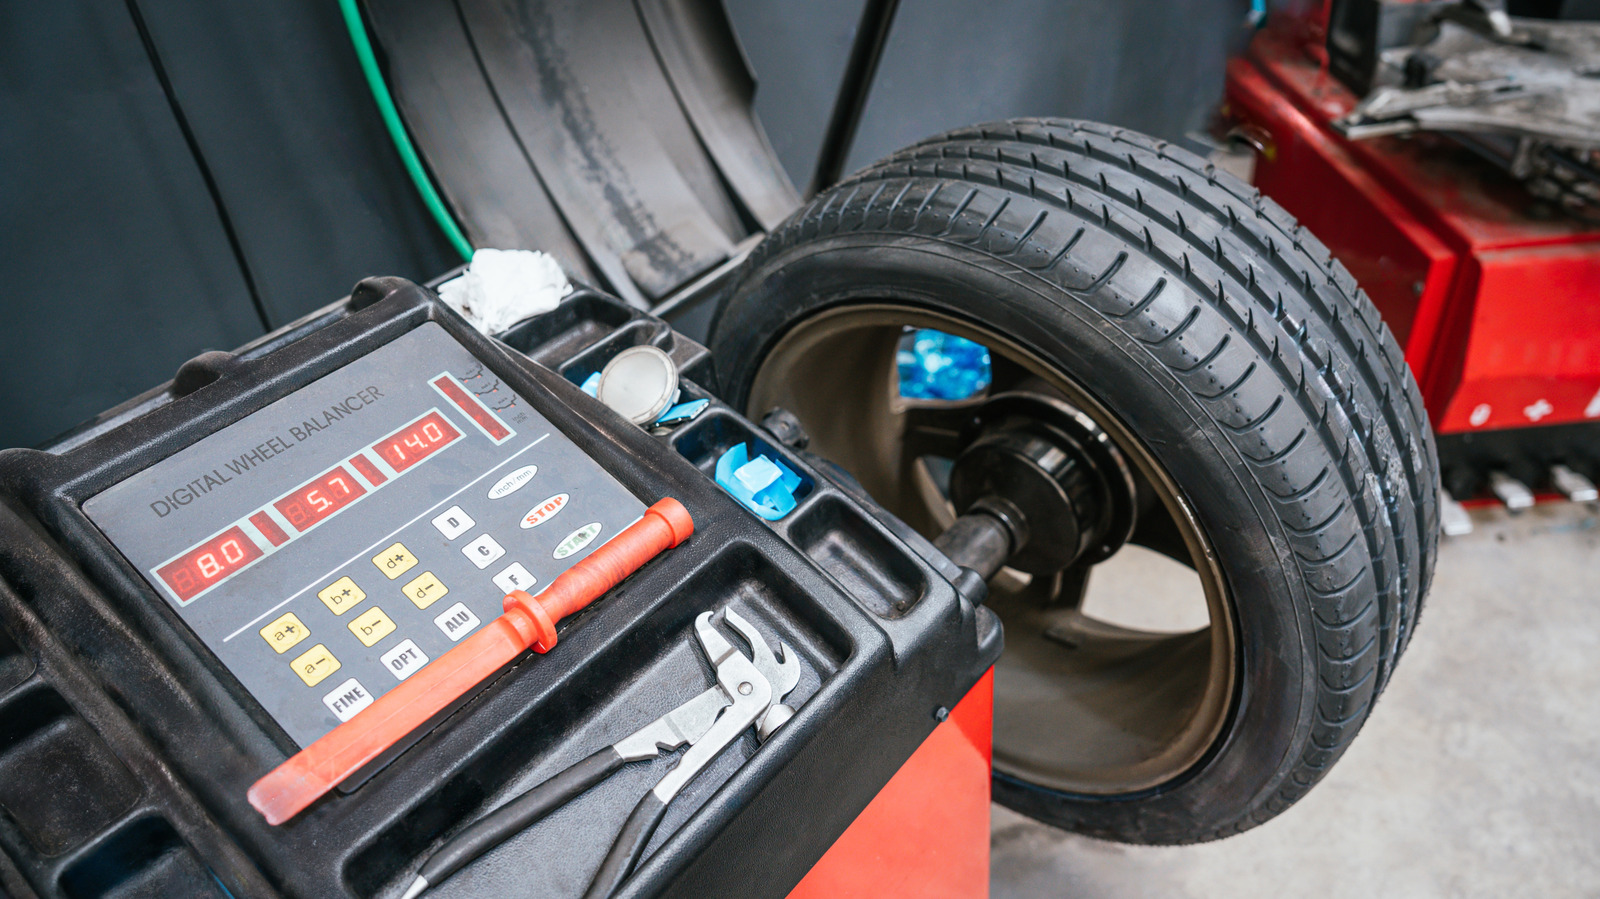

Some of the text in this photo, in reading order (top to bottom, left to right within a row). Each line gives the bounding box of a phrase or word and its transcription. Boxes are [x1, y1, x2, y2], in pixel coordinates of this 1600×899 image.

[150, 385, 385, 518] DIGITAL WHEEL BALANCER
[393, 422, 444, 460] 14.0
[494, 469, 532, 495] inch/mm
[306, 477, 350, 513] 5.7
[526, 496, 562, 524] STOP
[447, 517, 460, 528] D
[478, 545, 490, 556] C
[556, 524, 597, 556] START
[196, 539, 244, 578] 8.0
[386, 553, 404, 569] d+
[508, 574, 520, 586] F
[330, 588, 351, 605] b+
[274, 625, 295, 641] a+
[444, 611, 470, 633] ALU
[391, 648, 418, 671] OPT
[332, 687, 365, 714] FINE
